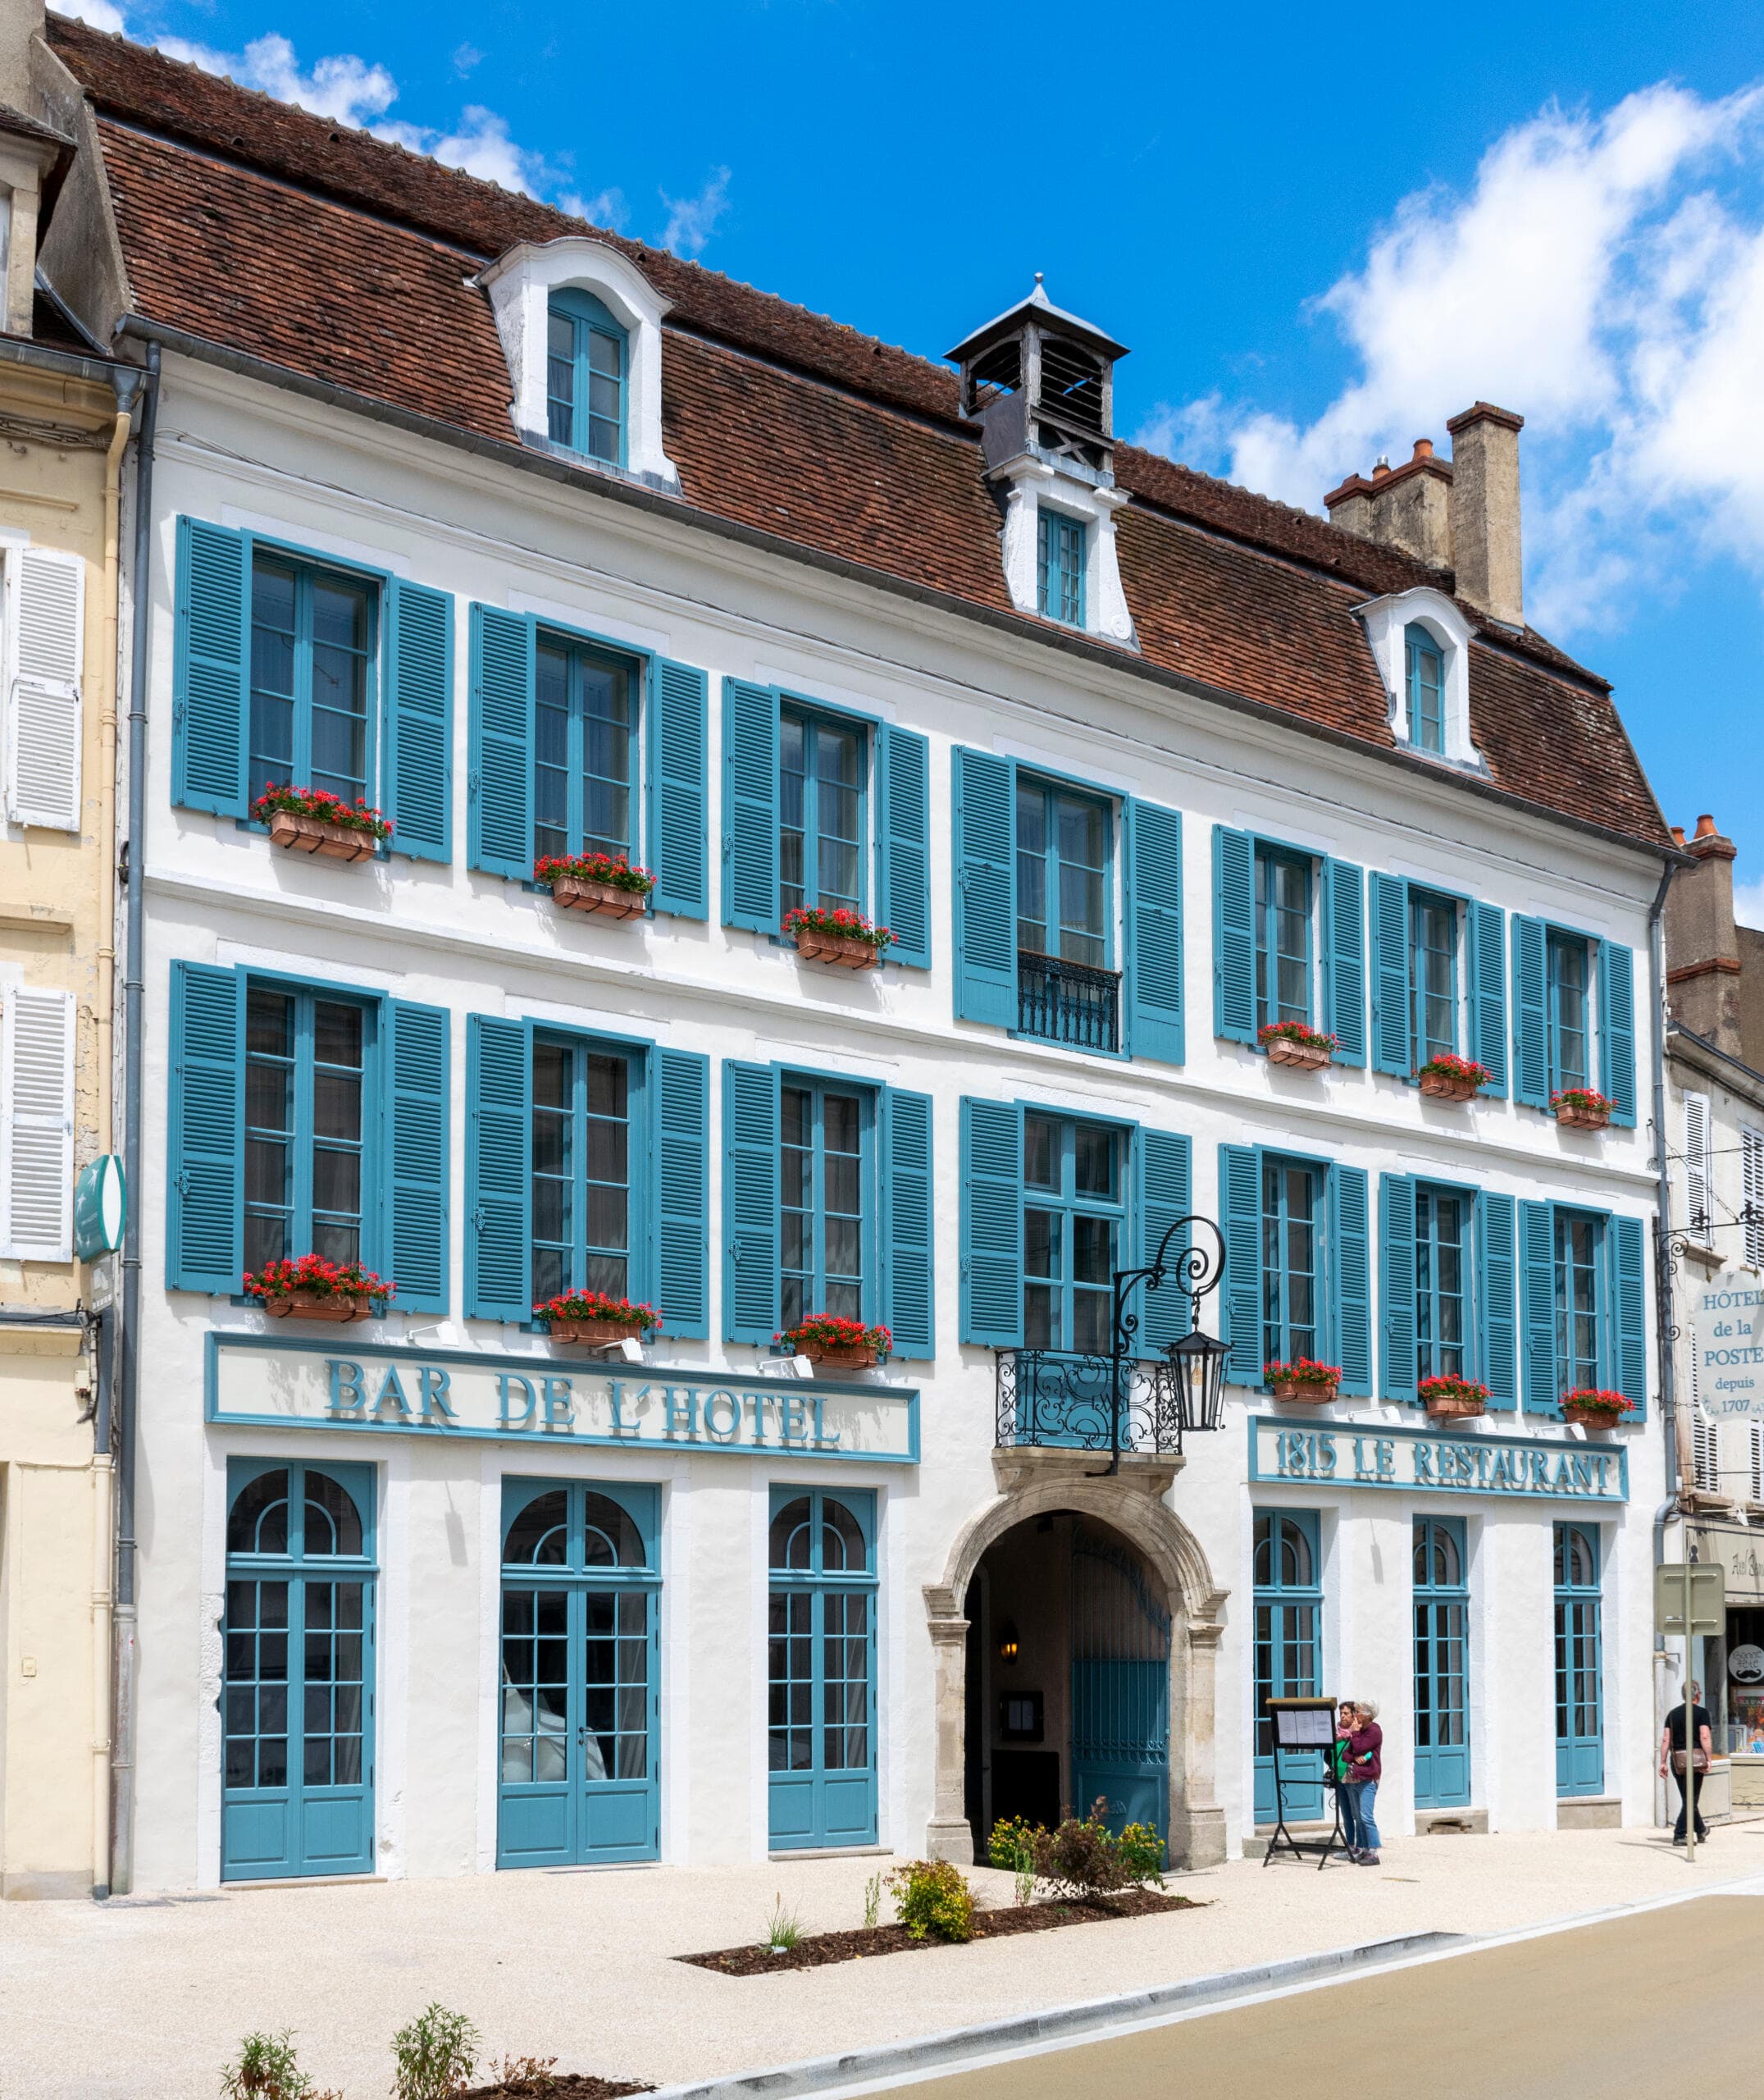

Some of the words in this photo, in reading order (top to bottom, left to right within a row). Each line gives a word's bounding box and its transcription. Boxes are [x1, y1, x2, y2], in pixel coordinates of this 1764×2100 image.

[1703, 1290, 1764, 1310] HÔTEL
[1713, 1321, 1732, 1337] de
[1737, 1319, 1753, 1335] la
[1704, 1347, 1764, 1367] POSTE
[1715, 1376, 1755, 1392] depuis
[324, 1358, 459, 1418] BAR
[495, 1373, 574, 1426] DE
[607, 1379, 841, 1442] L'HOTEL
[1722, 1399, 1750, 1413] 1707
[1276, 1431, 1337, 1472] 1815
[1353, 1436, 1396, 1476] LE
[1412, 1442, 1611, 1489] RESTAURANT
